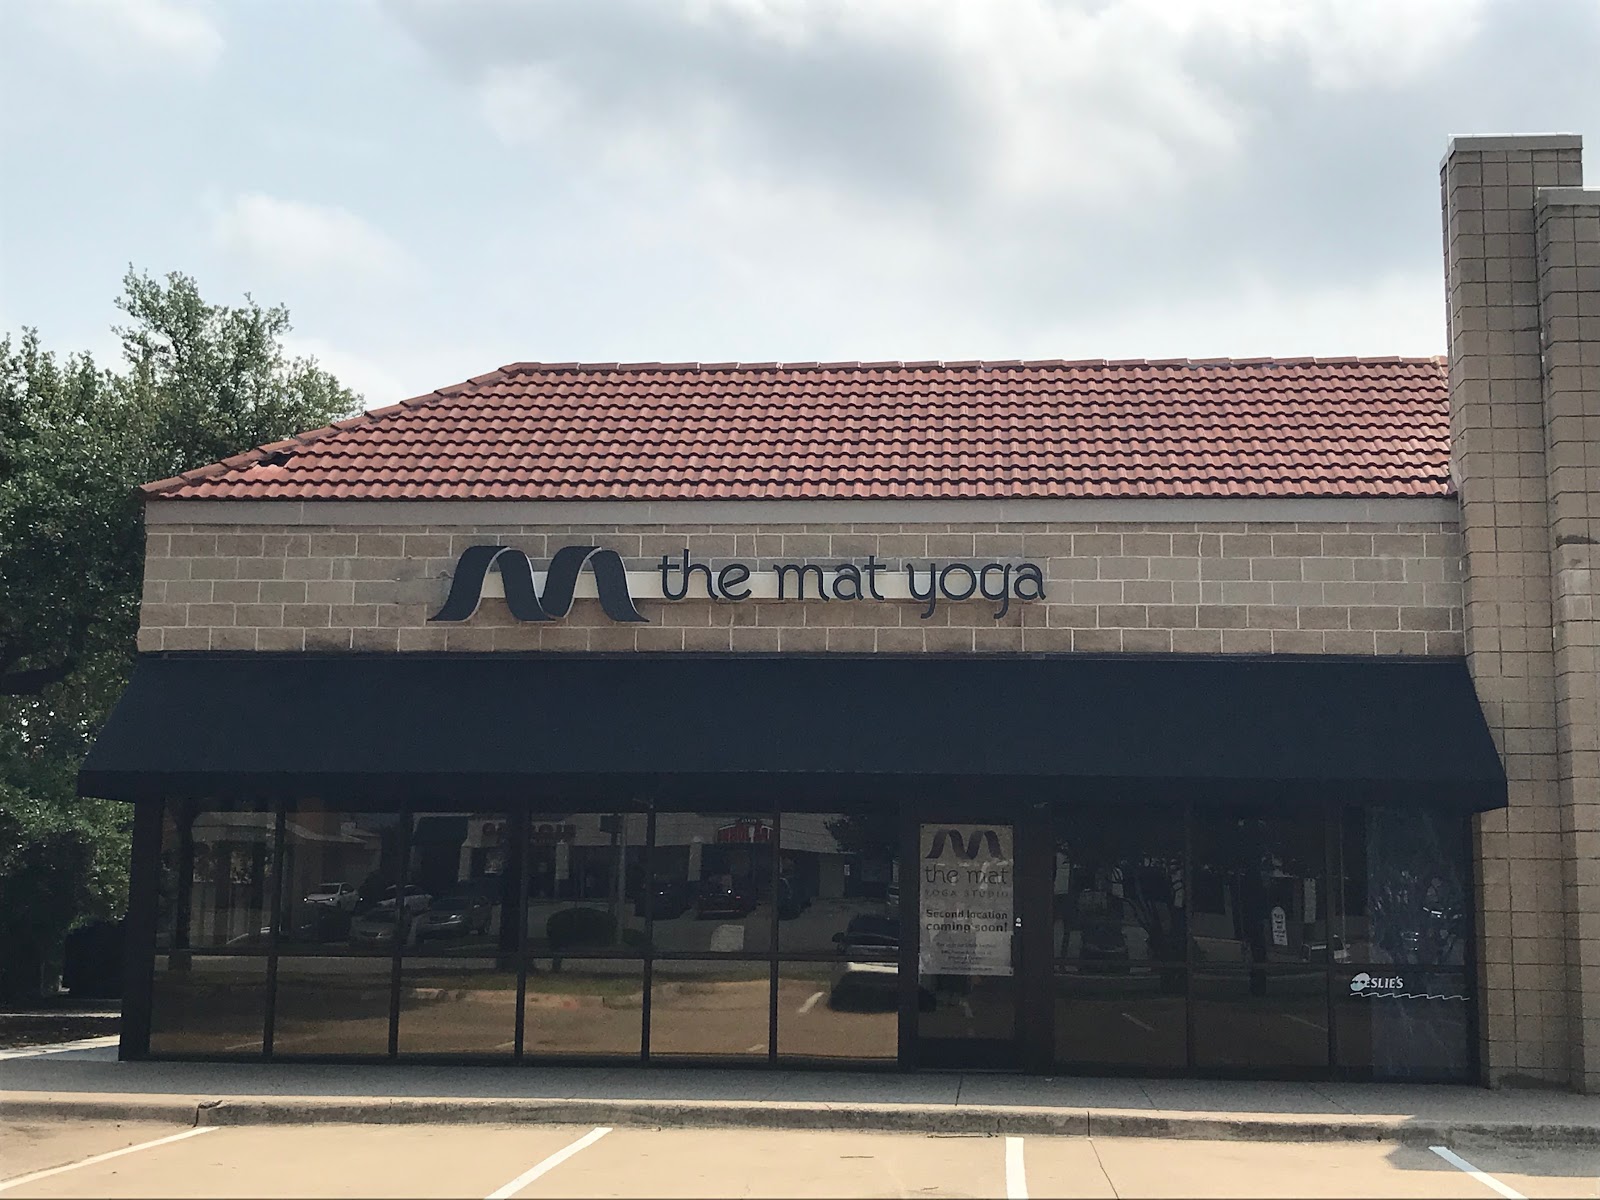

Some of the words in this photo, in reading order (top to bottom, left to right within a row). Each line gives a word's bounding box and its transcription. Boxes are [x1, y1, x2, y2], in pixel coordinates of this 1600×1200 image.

[658, 549, 751, 600] the
[773, 556, 886, 600] mat
[906, 562, 1047, 619] yoga
[925, 864, 959, 884] the
[967, 867, 1009, 885] mat
[926, 909, 964, 919] Second
[966, 909, 1008, 920] location
[926, 921, 971, 934] coming
